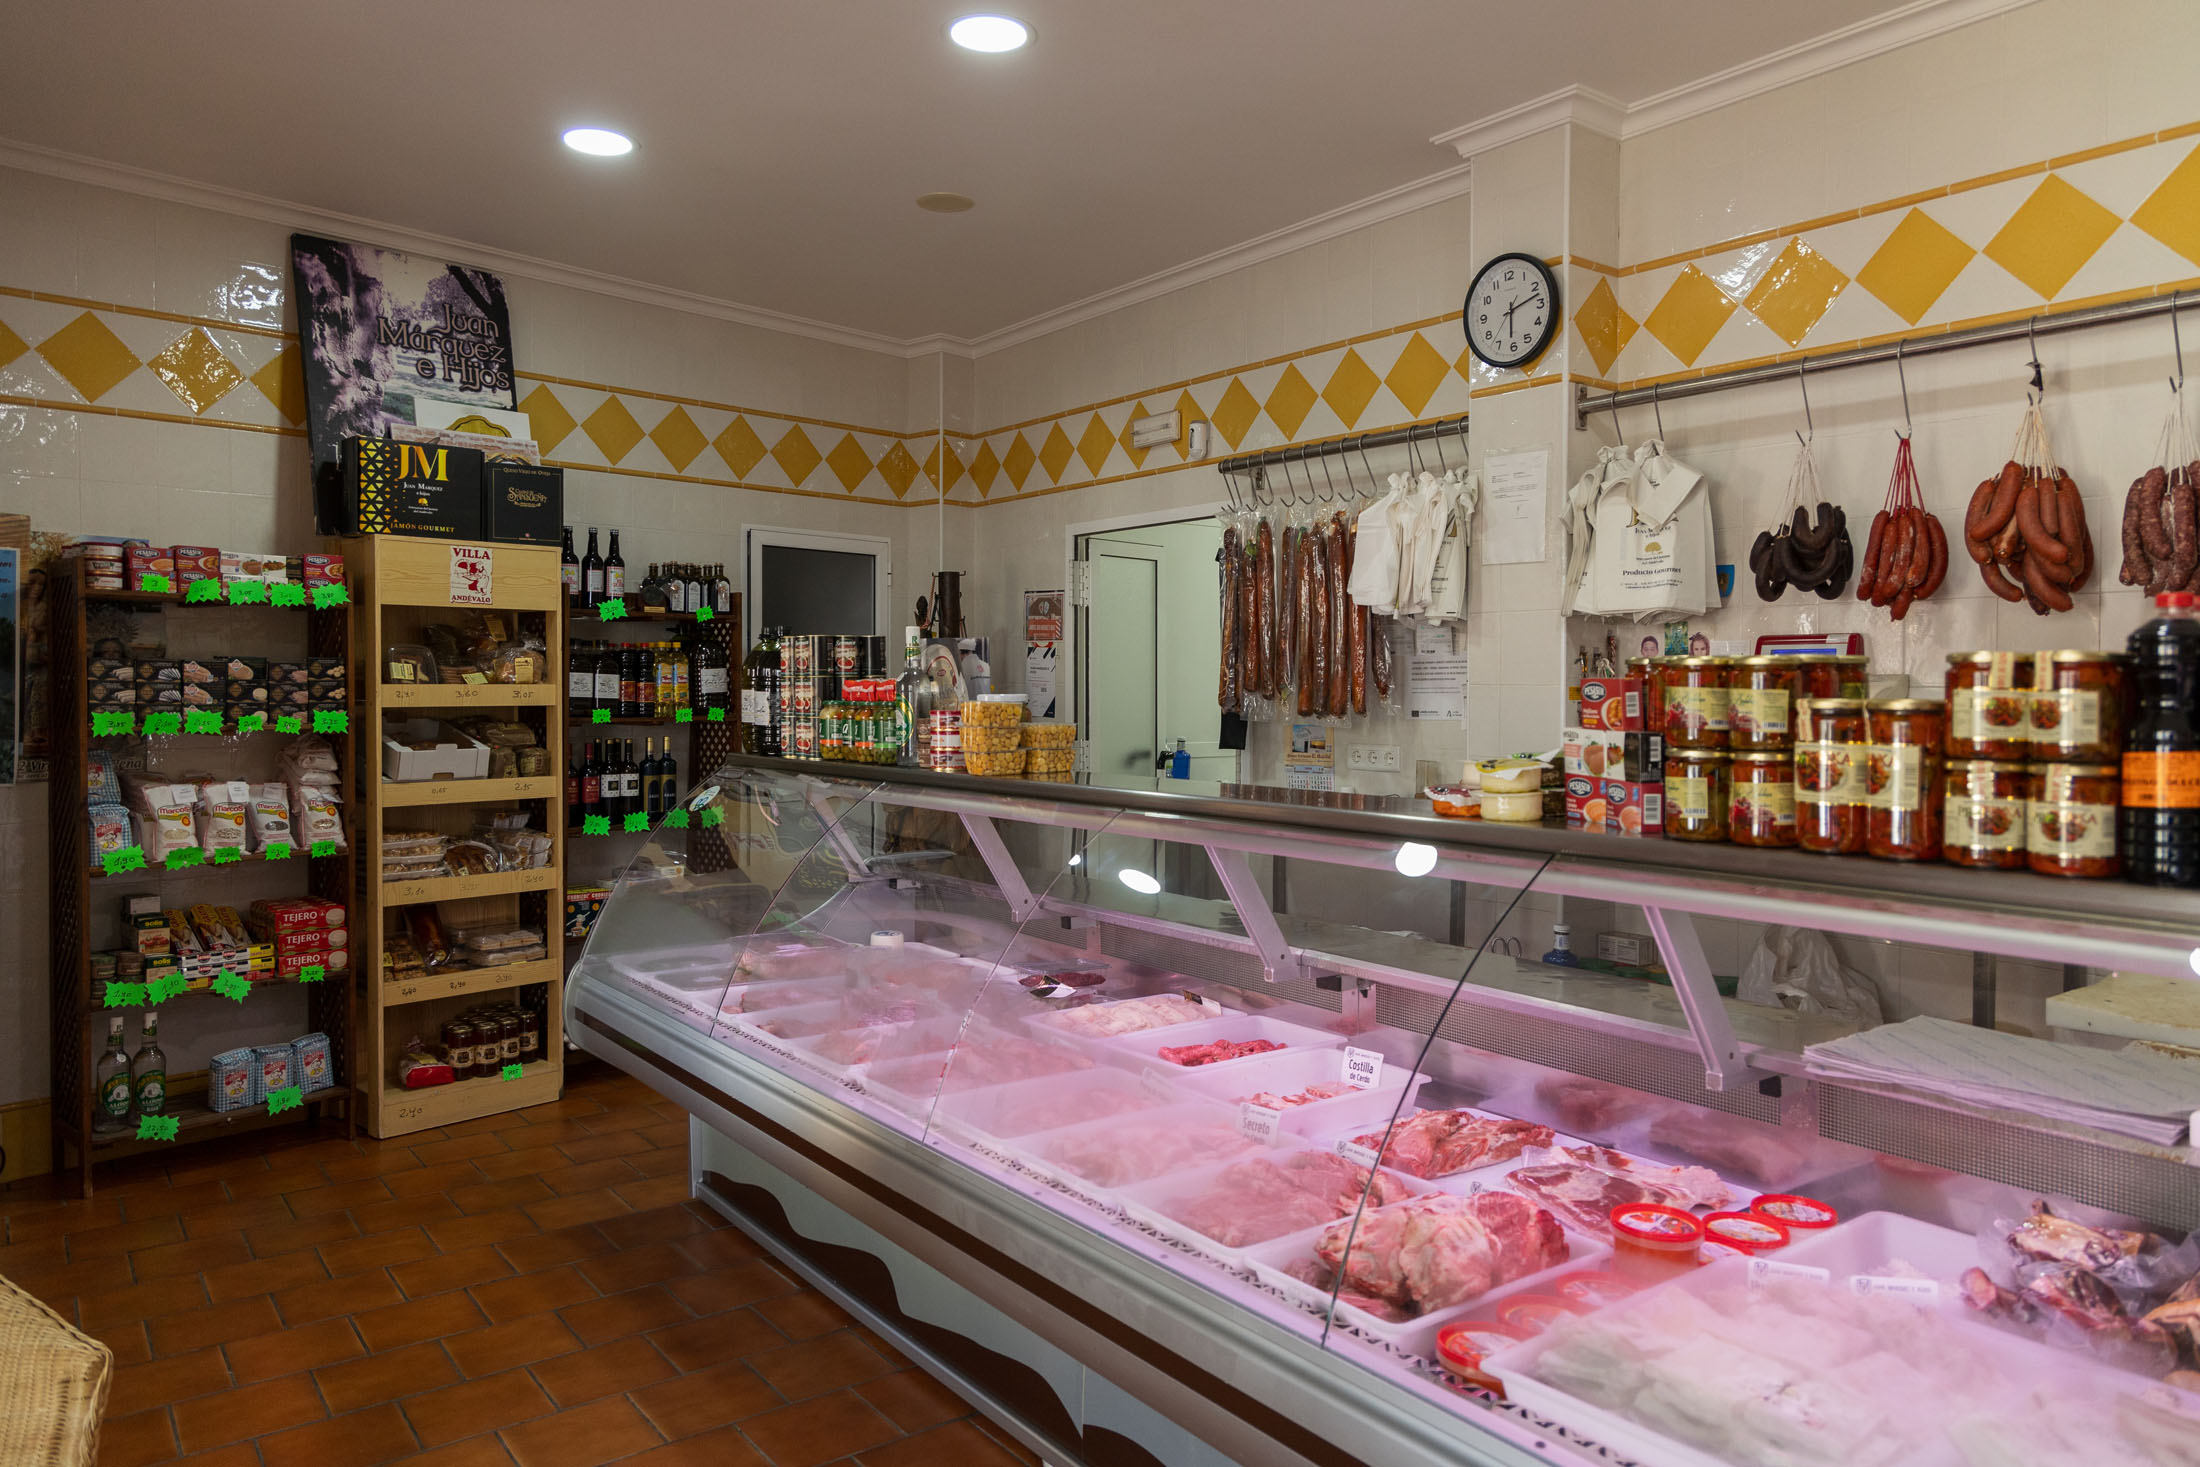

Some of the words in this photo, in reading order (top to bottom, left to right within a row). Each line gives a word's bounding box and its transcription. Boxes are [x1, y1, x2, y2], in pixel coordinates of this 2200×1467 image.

[1504, 270, 1515, 281] 12
[1492, 280, 1500, 291] 11
[1531, 281, 1539, 292] 2
[1483, 295, 1492, 306] 10
[1536, 298, 1545, 309] 3
[428, 303, 500, 338] Juan
[1480, 314, 1488, 324] 9
[1534, 316, 1542, 326] 4
[376, 316, 506, 363] Márquez
[1485, 330, 1493, 340] 8
[1523, 333, 1532, 343] 5
[1495, 340, 1502, 350] 7
[1510, 342, 1518, 352] 6
[417, 359, 436, 378] e
[443, 353, 511, 391] Hijos
[398, 443, 450, 482] JM
[417, 524, 455, 534] GOURMET
[453, 547, 491, 561] VILLA
[451, 594, 491, 603] ANDÉVALO
[215, 804, 244, 812] Marcos
[283, 911, 318, 923] TEJERO
[286, 932, 321, 945] TEJERO
[287, 954, 321, 966] TEJERO
[1349, 1058, 1374, 1074] Costilla
[1242, 1117, 1271, 1136] Secreto
